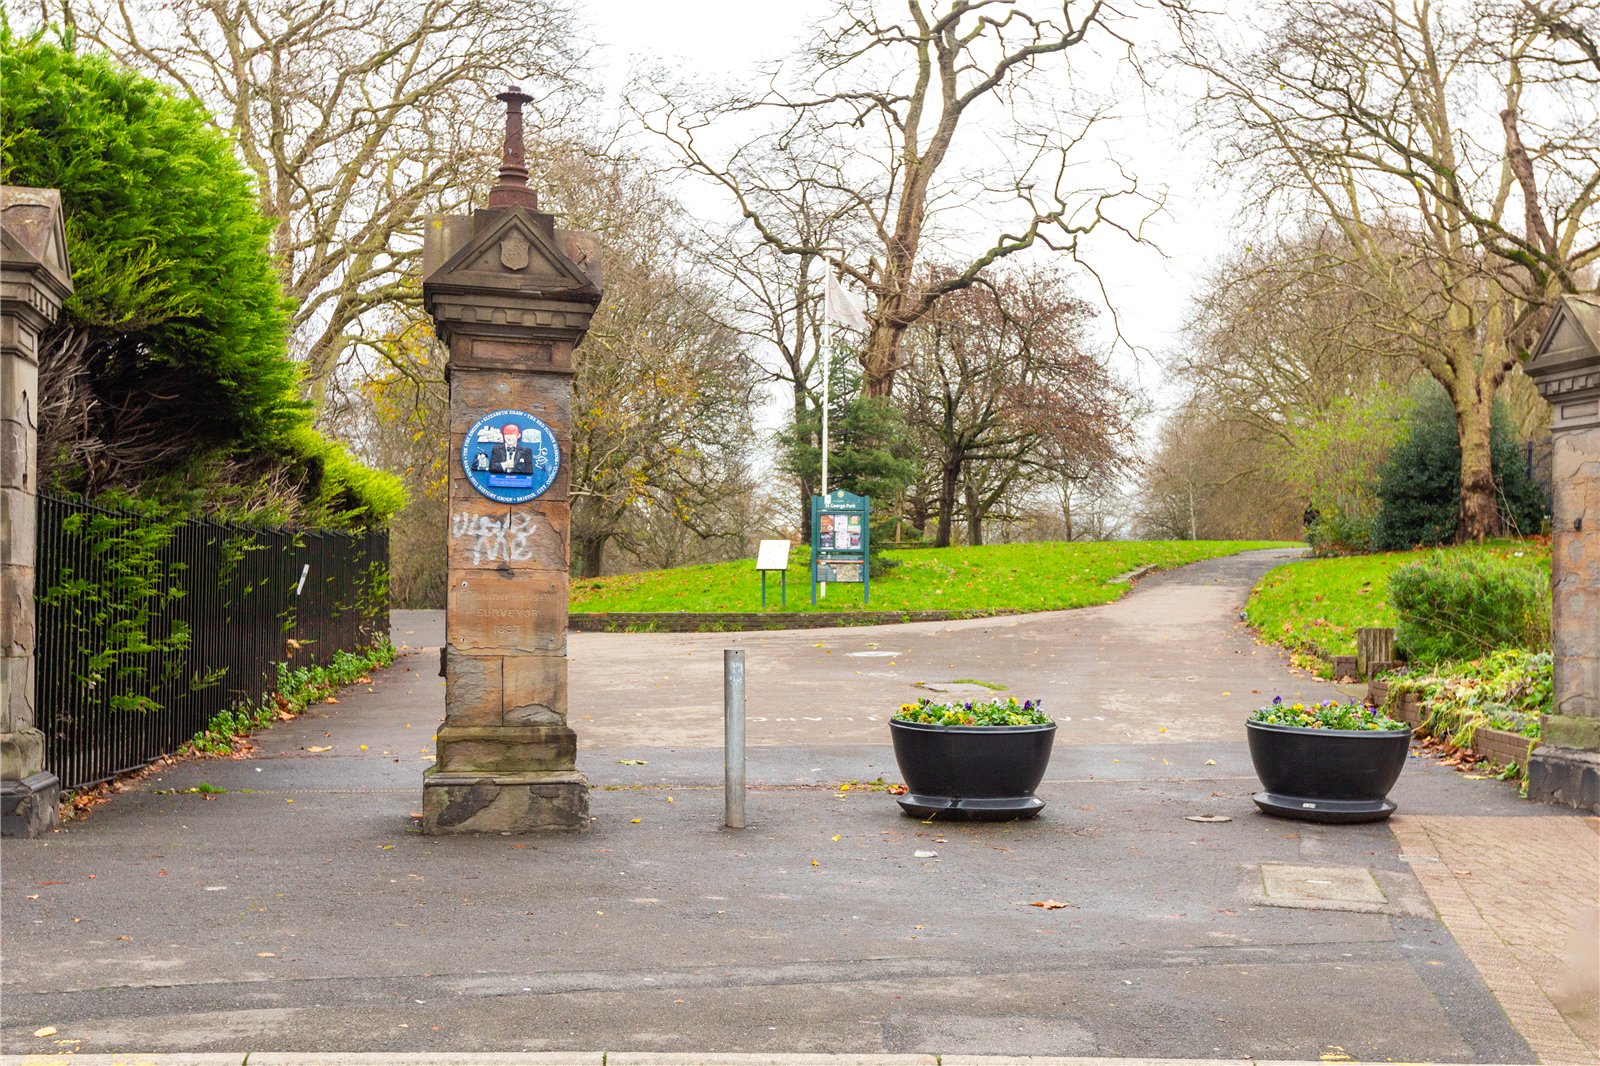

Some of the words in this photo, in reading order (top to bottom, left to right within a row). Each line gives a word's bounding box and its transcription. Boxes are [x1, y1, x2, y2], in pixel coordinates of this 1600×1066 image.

[483, 410, 508, 421] ELIZABETH
[527, 414, 537, 422] THE
[478, 486, 497, 499] HISTORY
[517, 493, 535, 501] BRISTOL
[537, 486, 547, 495] CITY
[477, 608, 541, 618] SURVEYOR
